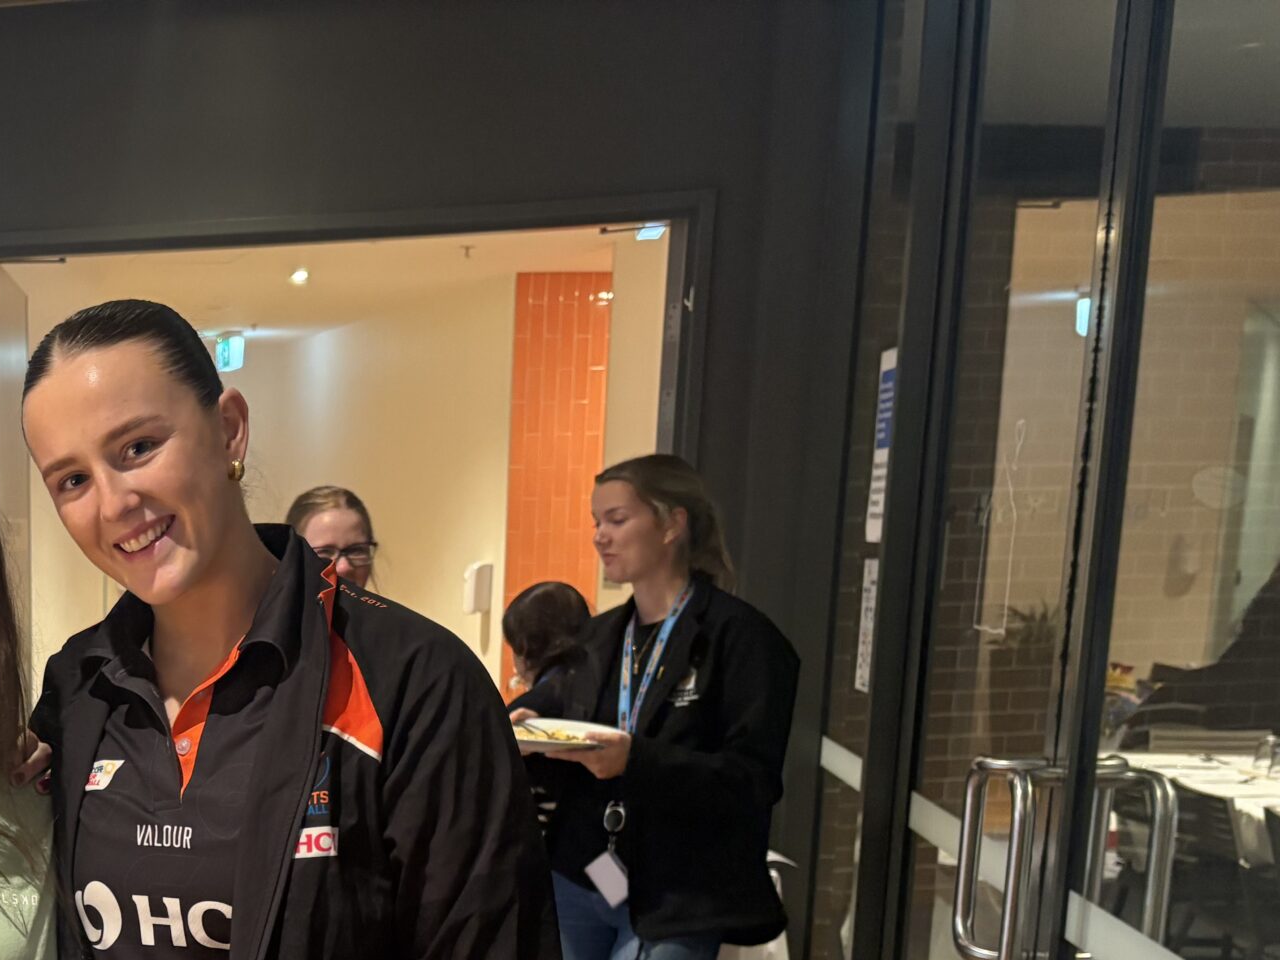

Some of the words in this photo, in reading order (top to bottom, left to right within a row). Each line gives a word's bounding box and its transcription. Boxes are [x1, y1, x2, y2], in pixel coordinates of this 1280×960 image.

[137, 824, 192, 849] VALOUR
[296, 832, 337, 854] HC
[132, 895, 232, 950] HC
